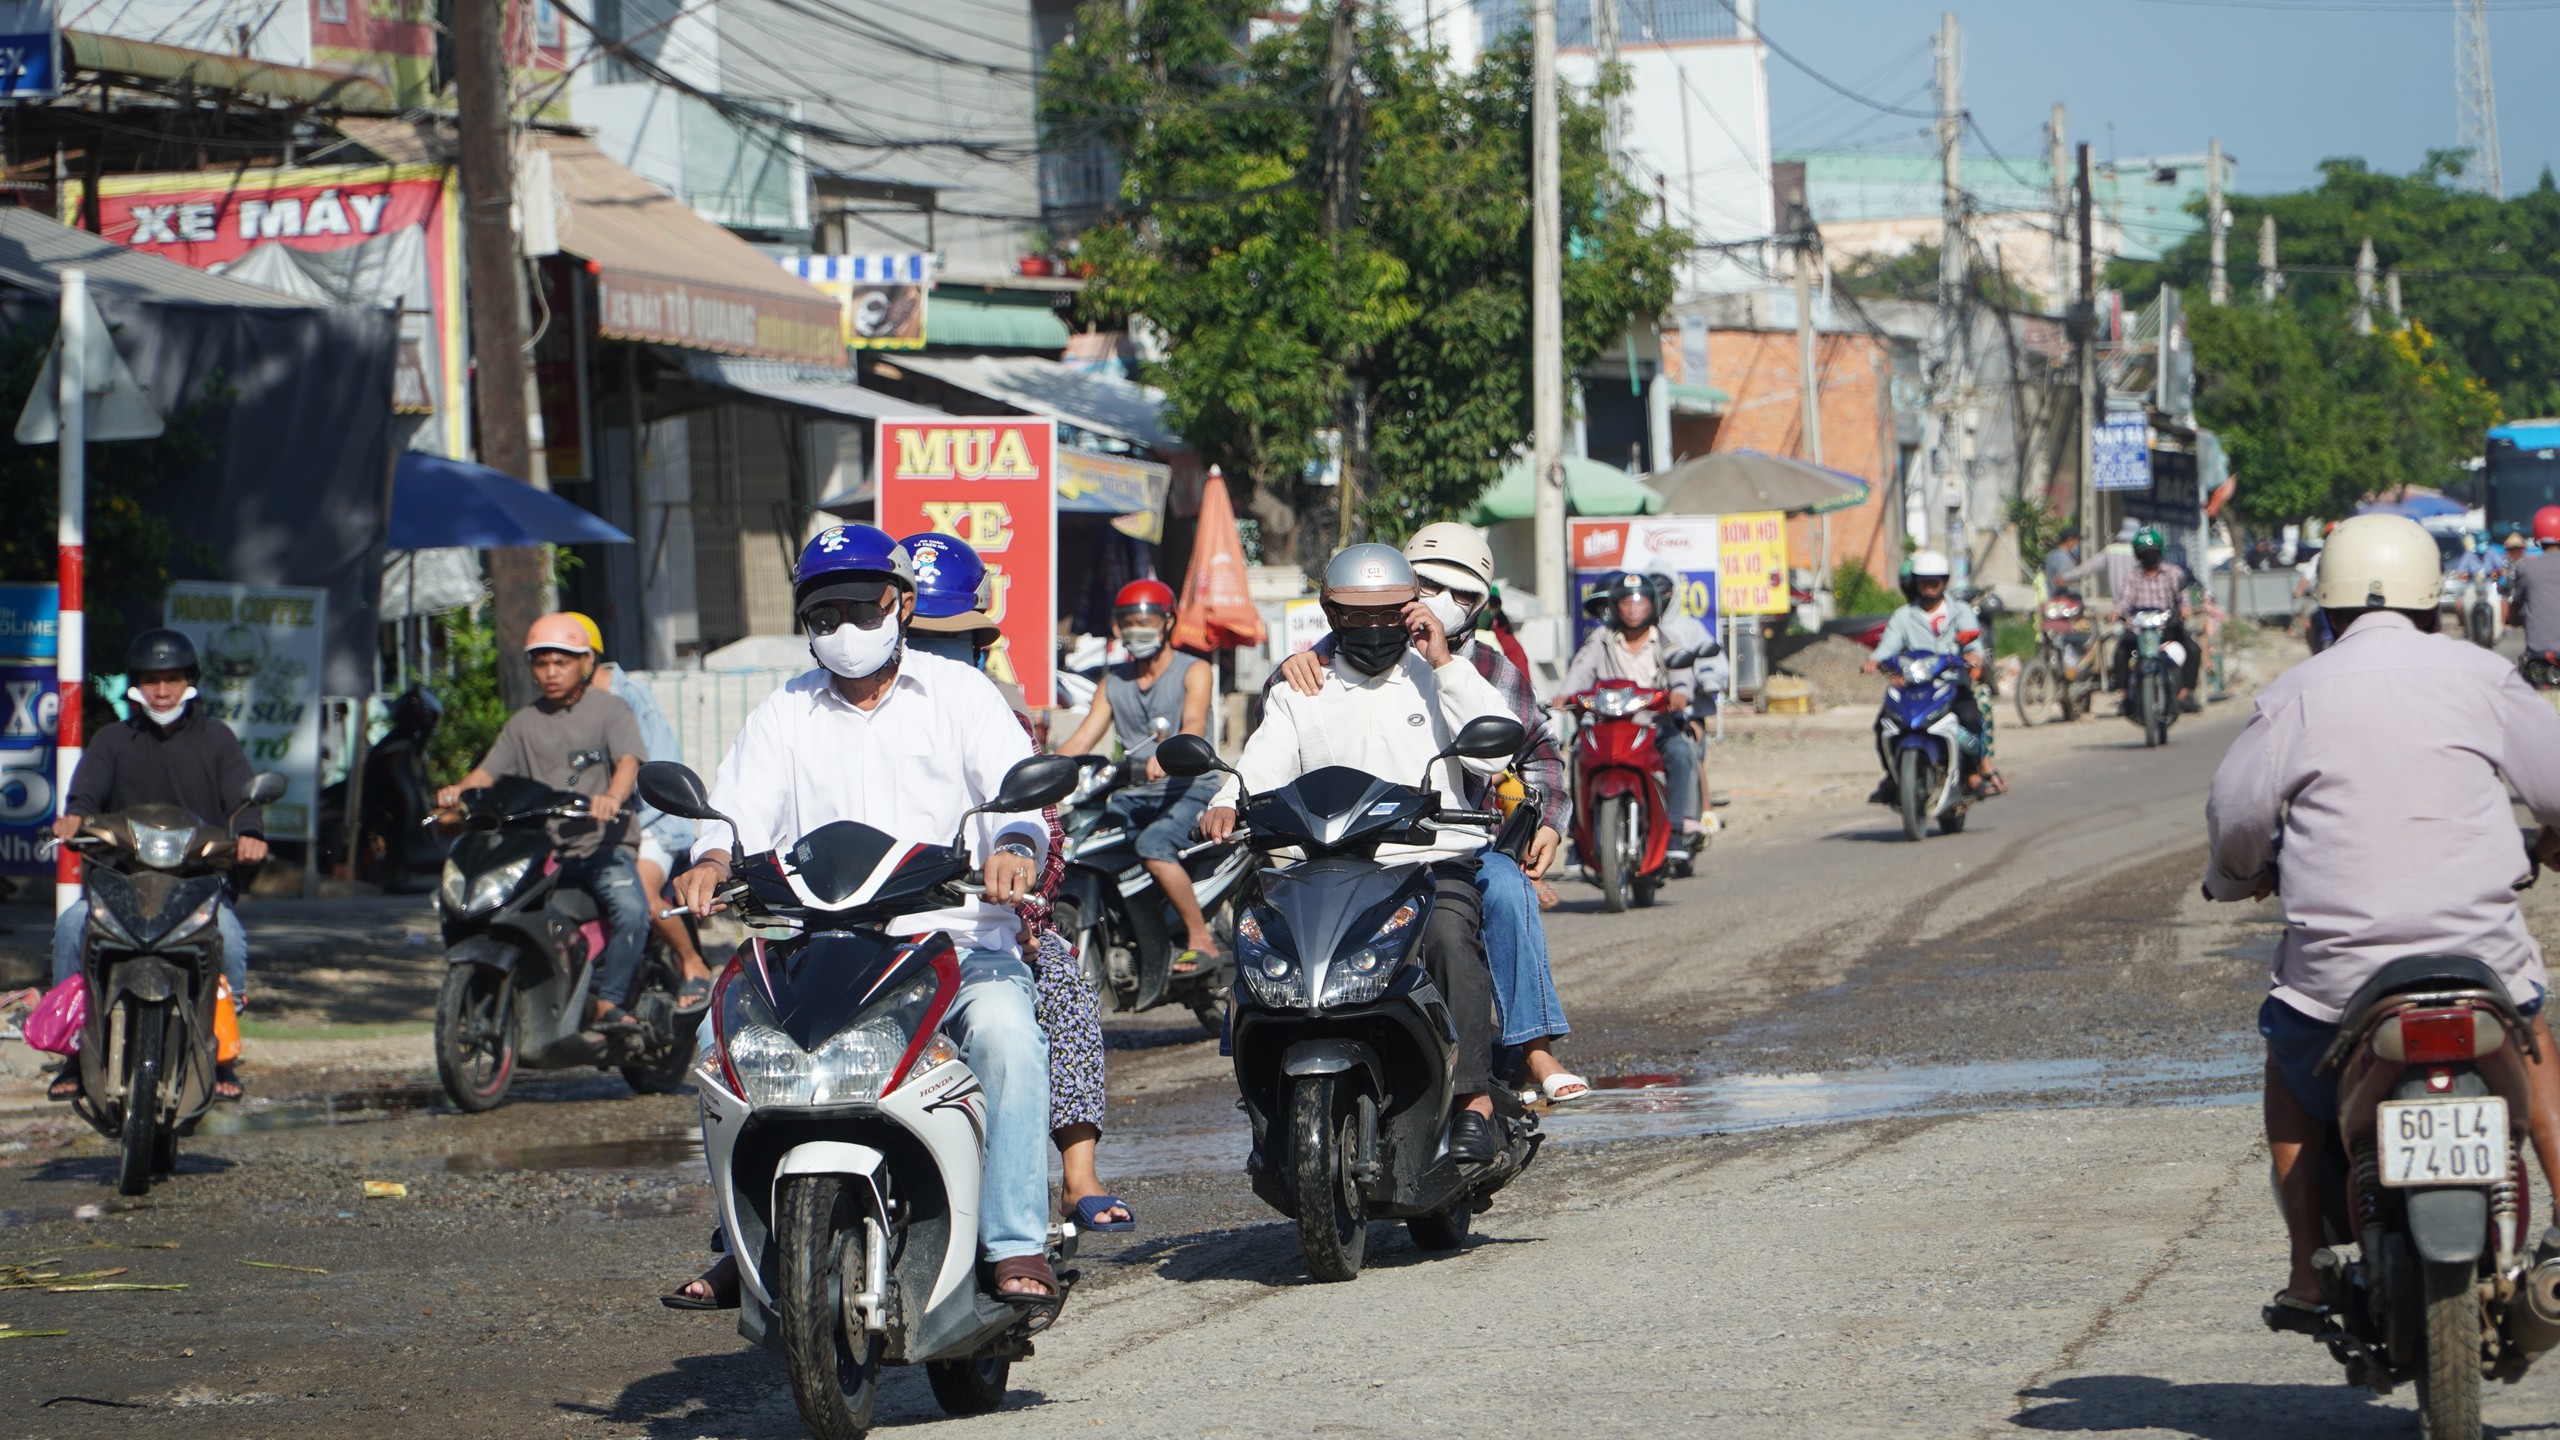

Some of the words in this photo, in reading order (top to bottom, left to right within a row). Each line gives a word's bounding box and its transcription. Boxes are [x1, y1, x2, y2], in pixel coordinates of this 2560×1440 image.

[131, 203, 216, 245] XE
[239, 189, 391, 239] MÁY
[895, 427, 1039, 480] MUA
[921, 501, 1012, 552] XE
[920, 1075, 954, 1098] HONDA
[2399, 1107, 2490, 1141] 60-L4
[2400, 1144, 2490, 1179] 7400
